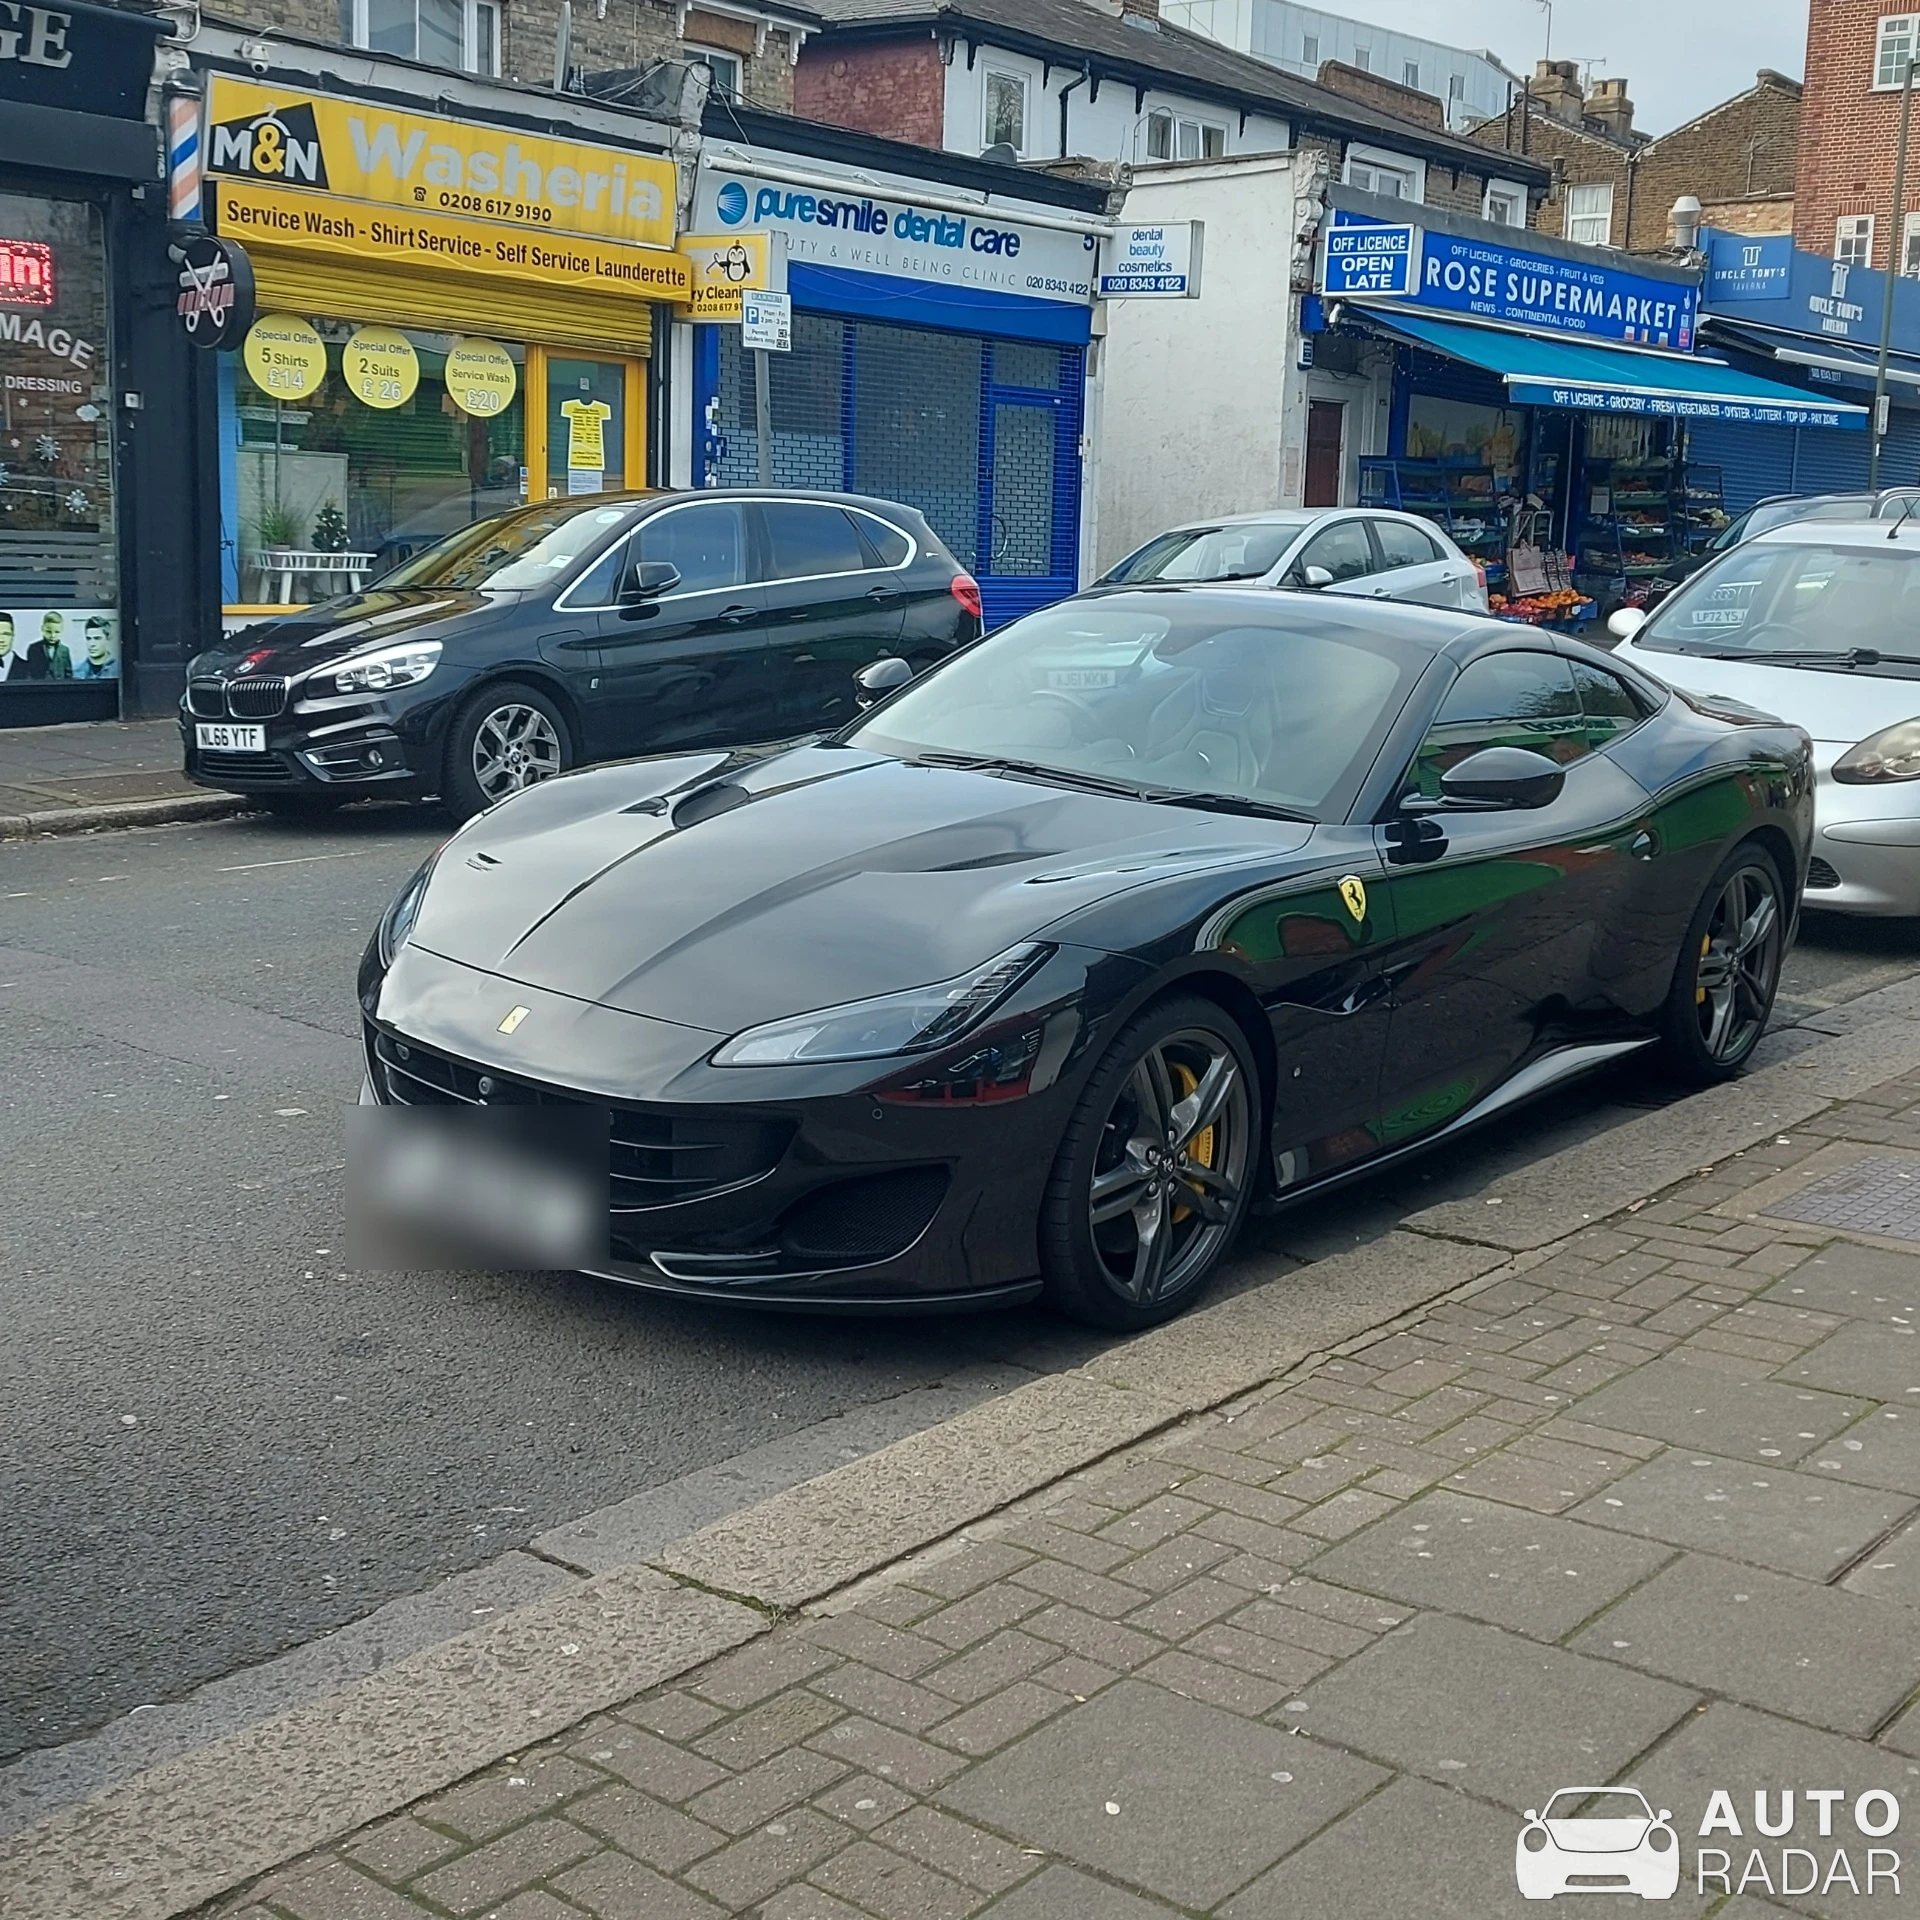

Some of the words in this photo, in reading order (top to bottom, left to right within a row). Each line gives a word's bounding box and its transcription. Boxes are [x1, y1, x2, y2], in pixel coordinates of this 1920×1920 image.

[213, 124, 318, 181] M&N
[348, 118, 664, 222] Washeria
[439, 192, 482, 212] 0208
[485, 200, 511, 216] 617
[515, 204, 552, 222] 9190
[227, 200, 300, 230] Service
[304, 211, 354, 238] Wash
[371, 222, 415, 248] Shirt
[418, 230, 482, 258] Service
[496, 241, 527, 264] Self
[531, 246, 590, 273] Service
[595, 256, 686, 286] Launderette
[894, 208, 966, 249] dental
[970, 226, 1020, 257] care
[1132, 228, 1163, 241] dental
[1333, 237, 1355, 251] OFF
[1357, 235, 1406, 251] LICENCE
[1129, 244, 1165, 258] beauty
[851, 248, 890, 266] WELL
[902, 257, 951, 275] BEING
[962, 267, 1016, 286] CLINIC
[1118, 260, 1172, 272] cosmetics
[1341, 256, 1394, 272] OPEN
[1451, 245, 1468, 256] OFF
[1469, 249, 1504, 265] LICENCE
[1510, 257, 1555, 275] GROCERIES
[1560, 267, 1581, 280] FRUIT
[1589, 274, 1605, 285] VEG
[1715, 269, 1746, 280] UNCLE
[1752, 267, 1786, 279] TONY'S
[1026, 275, 1043, 289] 020
[1045, 278, 1067, 292] 8343
[1068, 282, 1089, 296] 4122
[1107, 278, 1127, 290] 020
[1129, 278, 1155, 290] 8343
[1157, 277, 1181, 290] 4122
[1345, 274, 1392, 289] LATE
[1426, 257, 1497, 297] ROSE
[1505, 273, 1676, 329] SUPERMARKET
[697, 303, 718, 312] 0208
[719, 303, 732, 312] 617
[1471, 300, 1496, 314] NEWS
[1505, 307, 1562, 326] CONTINENTAL
[1563, 316, 1586, 329] FOOD
[0, 312, 94, 370] MAGE
[255, 328, 291, 342] Special
[293, 332, 318, 344] Offer
[352, 339, 387, 353] Special
[389, 344, 412, 355] Offer
[261, 348, 271, 364] 5
[274, 353, 309, 368] Shirts
[359, 357, 369, 374] 2
[371, 363, 400, 378] Suits
[454, 350, 487, 363] Special
[488, 354, 509, 366] Offer
[5, 375, 82, 394] DRESSING
[268, 367, 304, 389] £14
[451, 368, 485, 381] Service
[486, 372, 511, 384] Wash
[465, 387, 500, 411] £20
[1553, 390, 1569, 404] OFF
[1570, 391, 1605, 407] LICENCE
[1610, 396, 1646, 411] GROCERY
[1651, 400, 1675, 413] FRESH
[1676, 402, 1720, 416] VEGETABLES
[1725, 406, 1751, 419] OYSTER
[1754, 409, 1783, 421] LOTTERY
[1799, 412, 1807, 424] UP
[1811, 413, 1823, 424] PAY
[1823, 414, 1839, 426] ZONE
[200, 727, 228, 746] NL66
[231, 728, 257, 748] YTF
